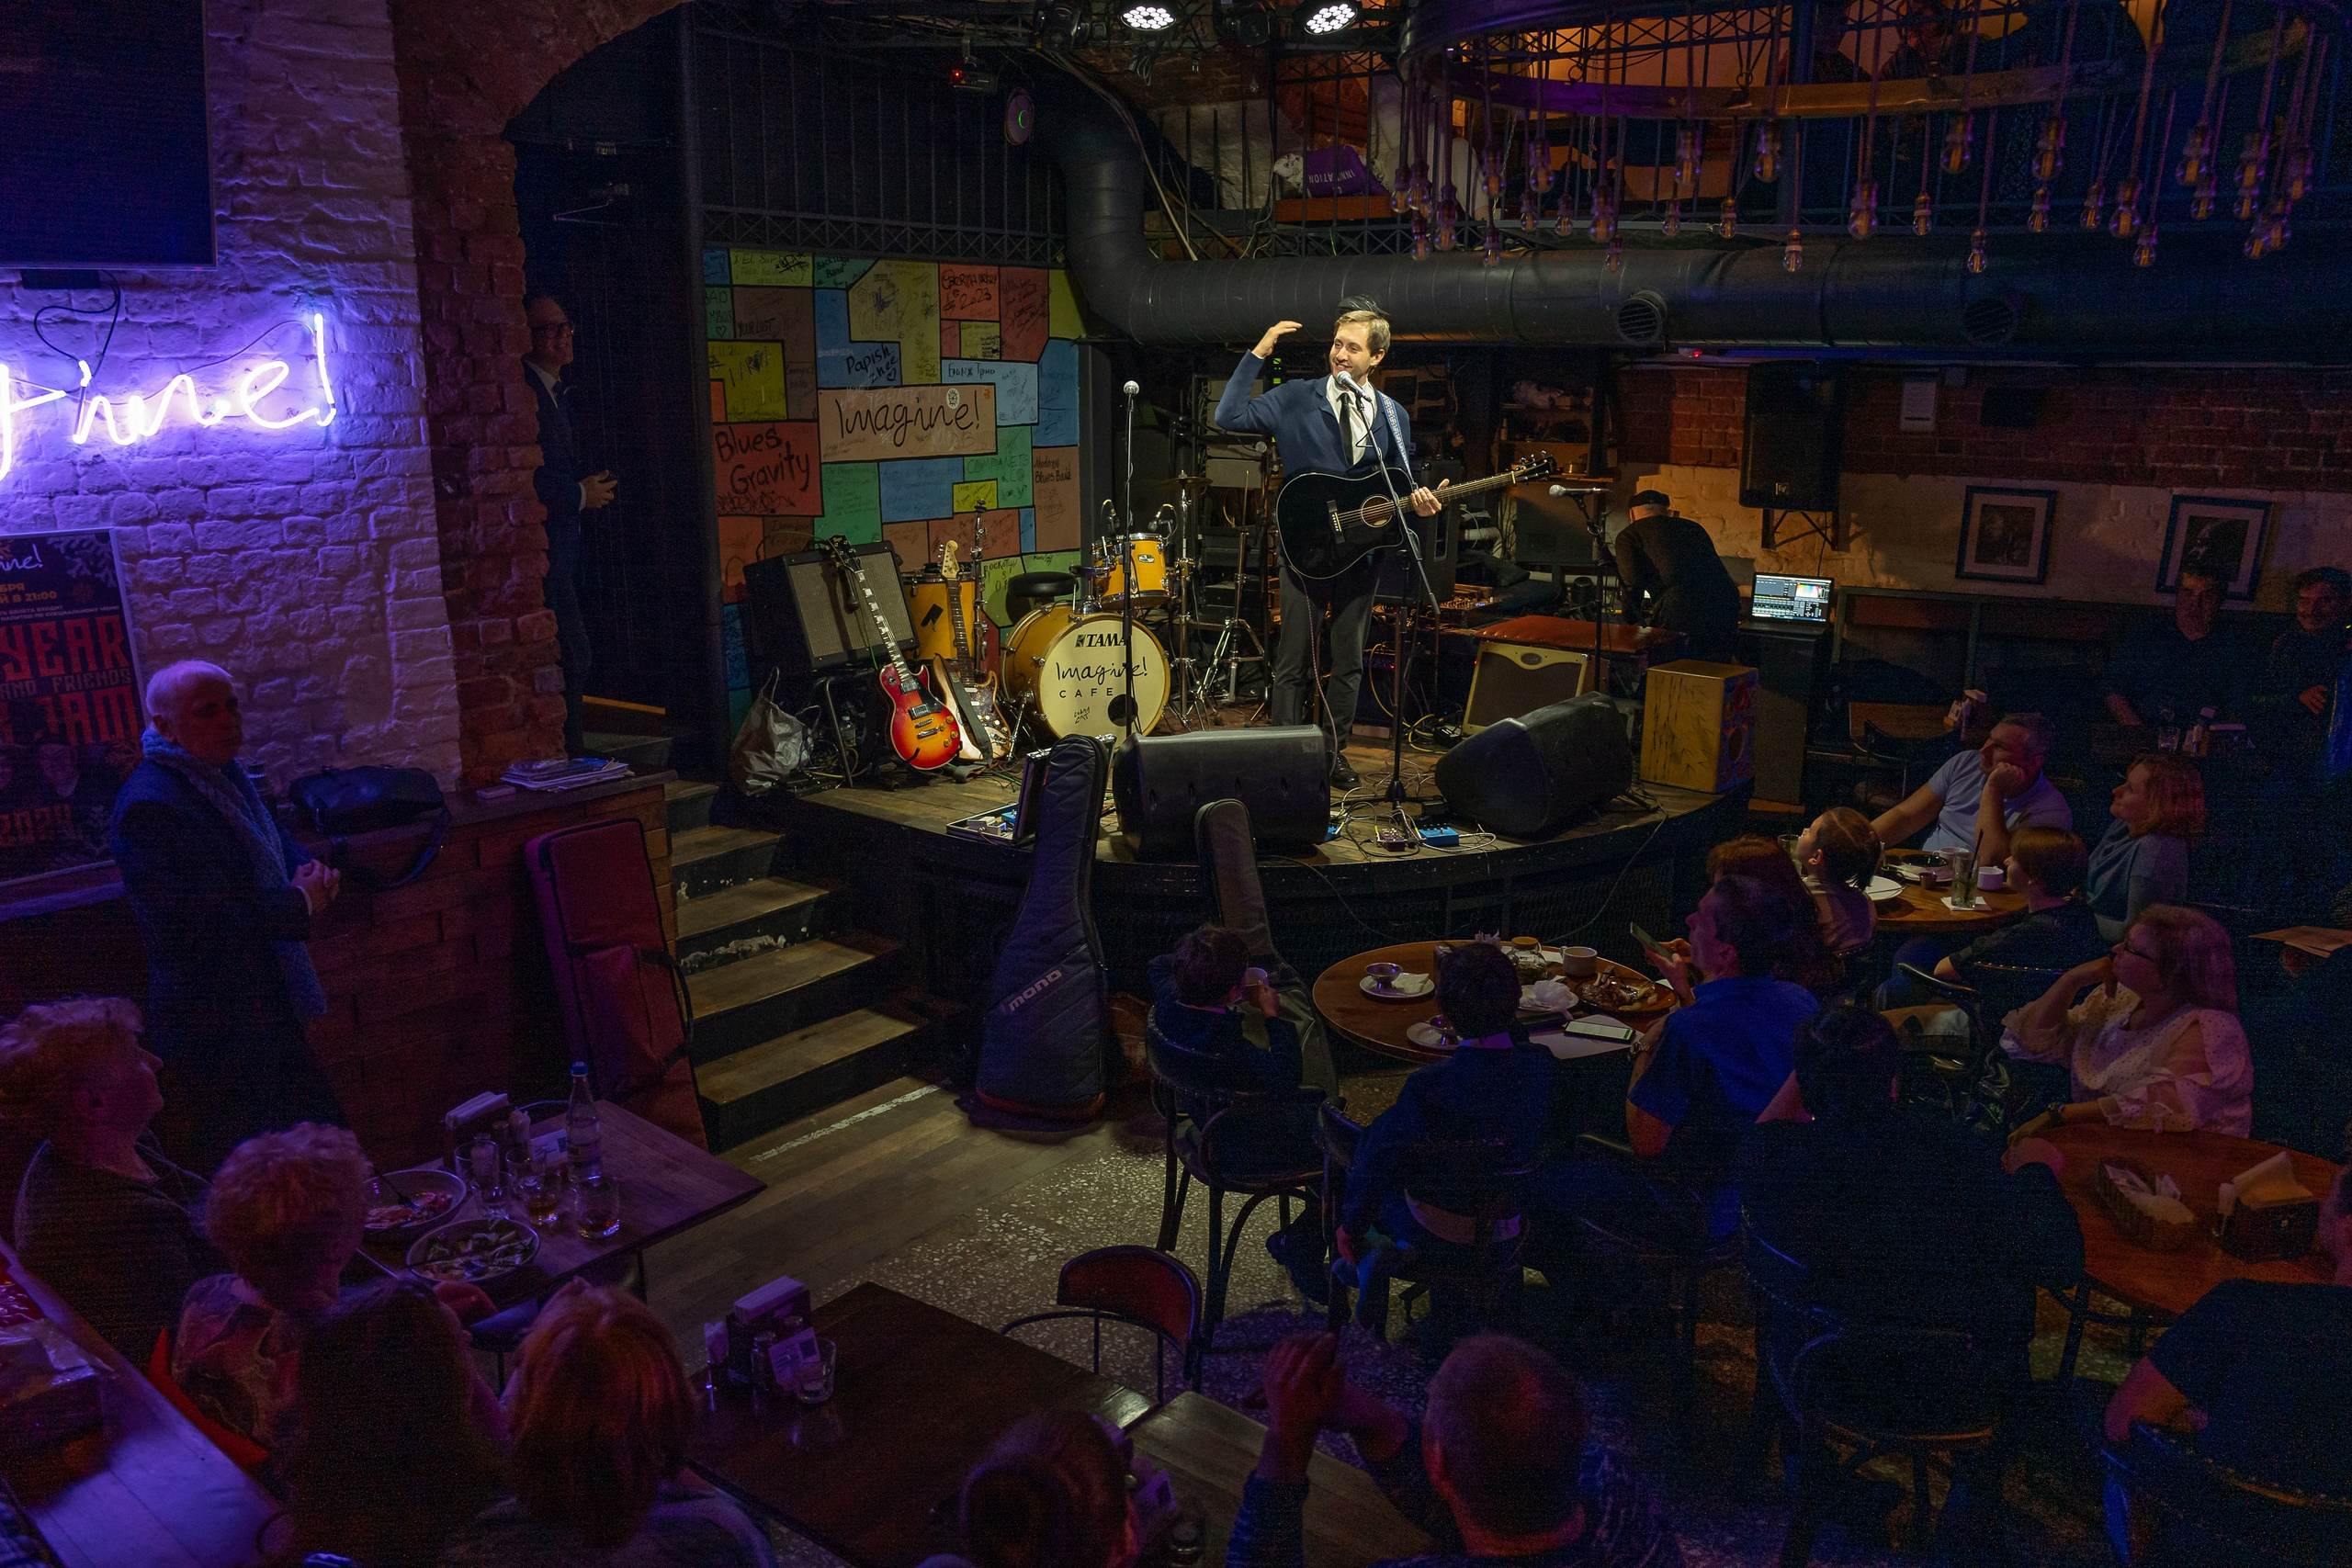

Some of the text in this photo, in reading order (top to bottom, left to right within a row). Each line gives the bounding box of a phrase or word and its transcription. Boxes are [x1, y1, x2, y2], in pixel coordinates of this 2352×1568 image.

[1308, 169, 1356, 184] INNATION
[846, 343, 891, 374] Papish
[835, 389, 980, 447] Imagine!
[715, 423, 783, 462] Blues
[730, 441, 810, 494] Gravity
[25, 591, 57, 603] 21:00
[37, 604, 63, 613] ВХОДИТ
[45, 607, 99, 617] СПЕЦИАЛЬНОМУ
[52, 668, 131, 694] FRIENDS
[1059, 687, 1114, 698] CAFE
[1007, 969, 1062, 1012] mono
